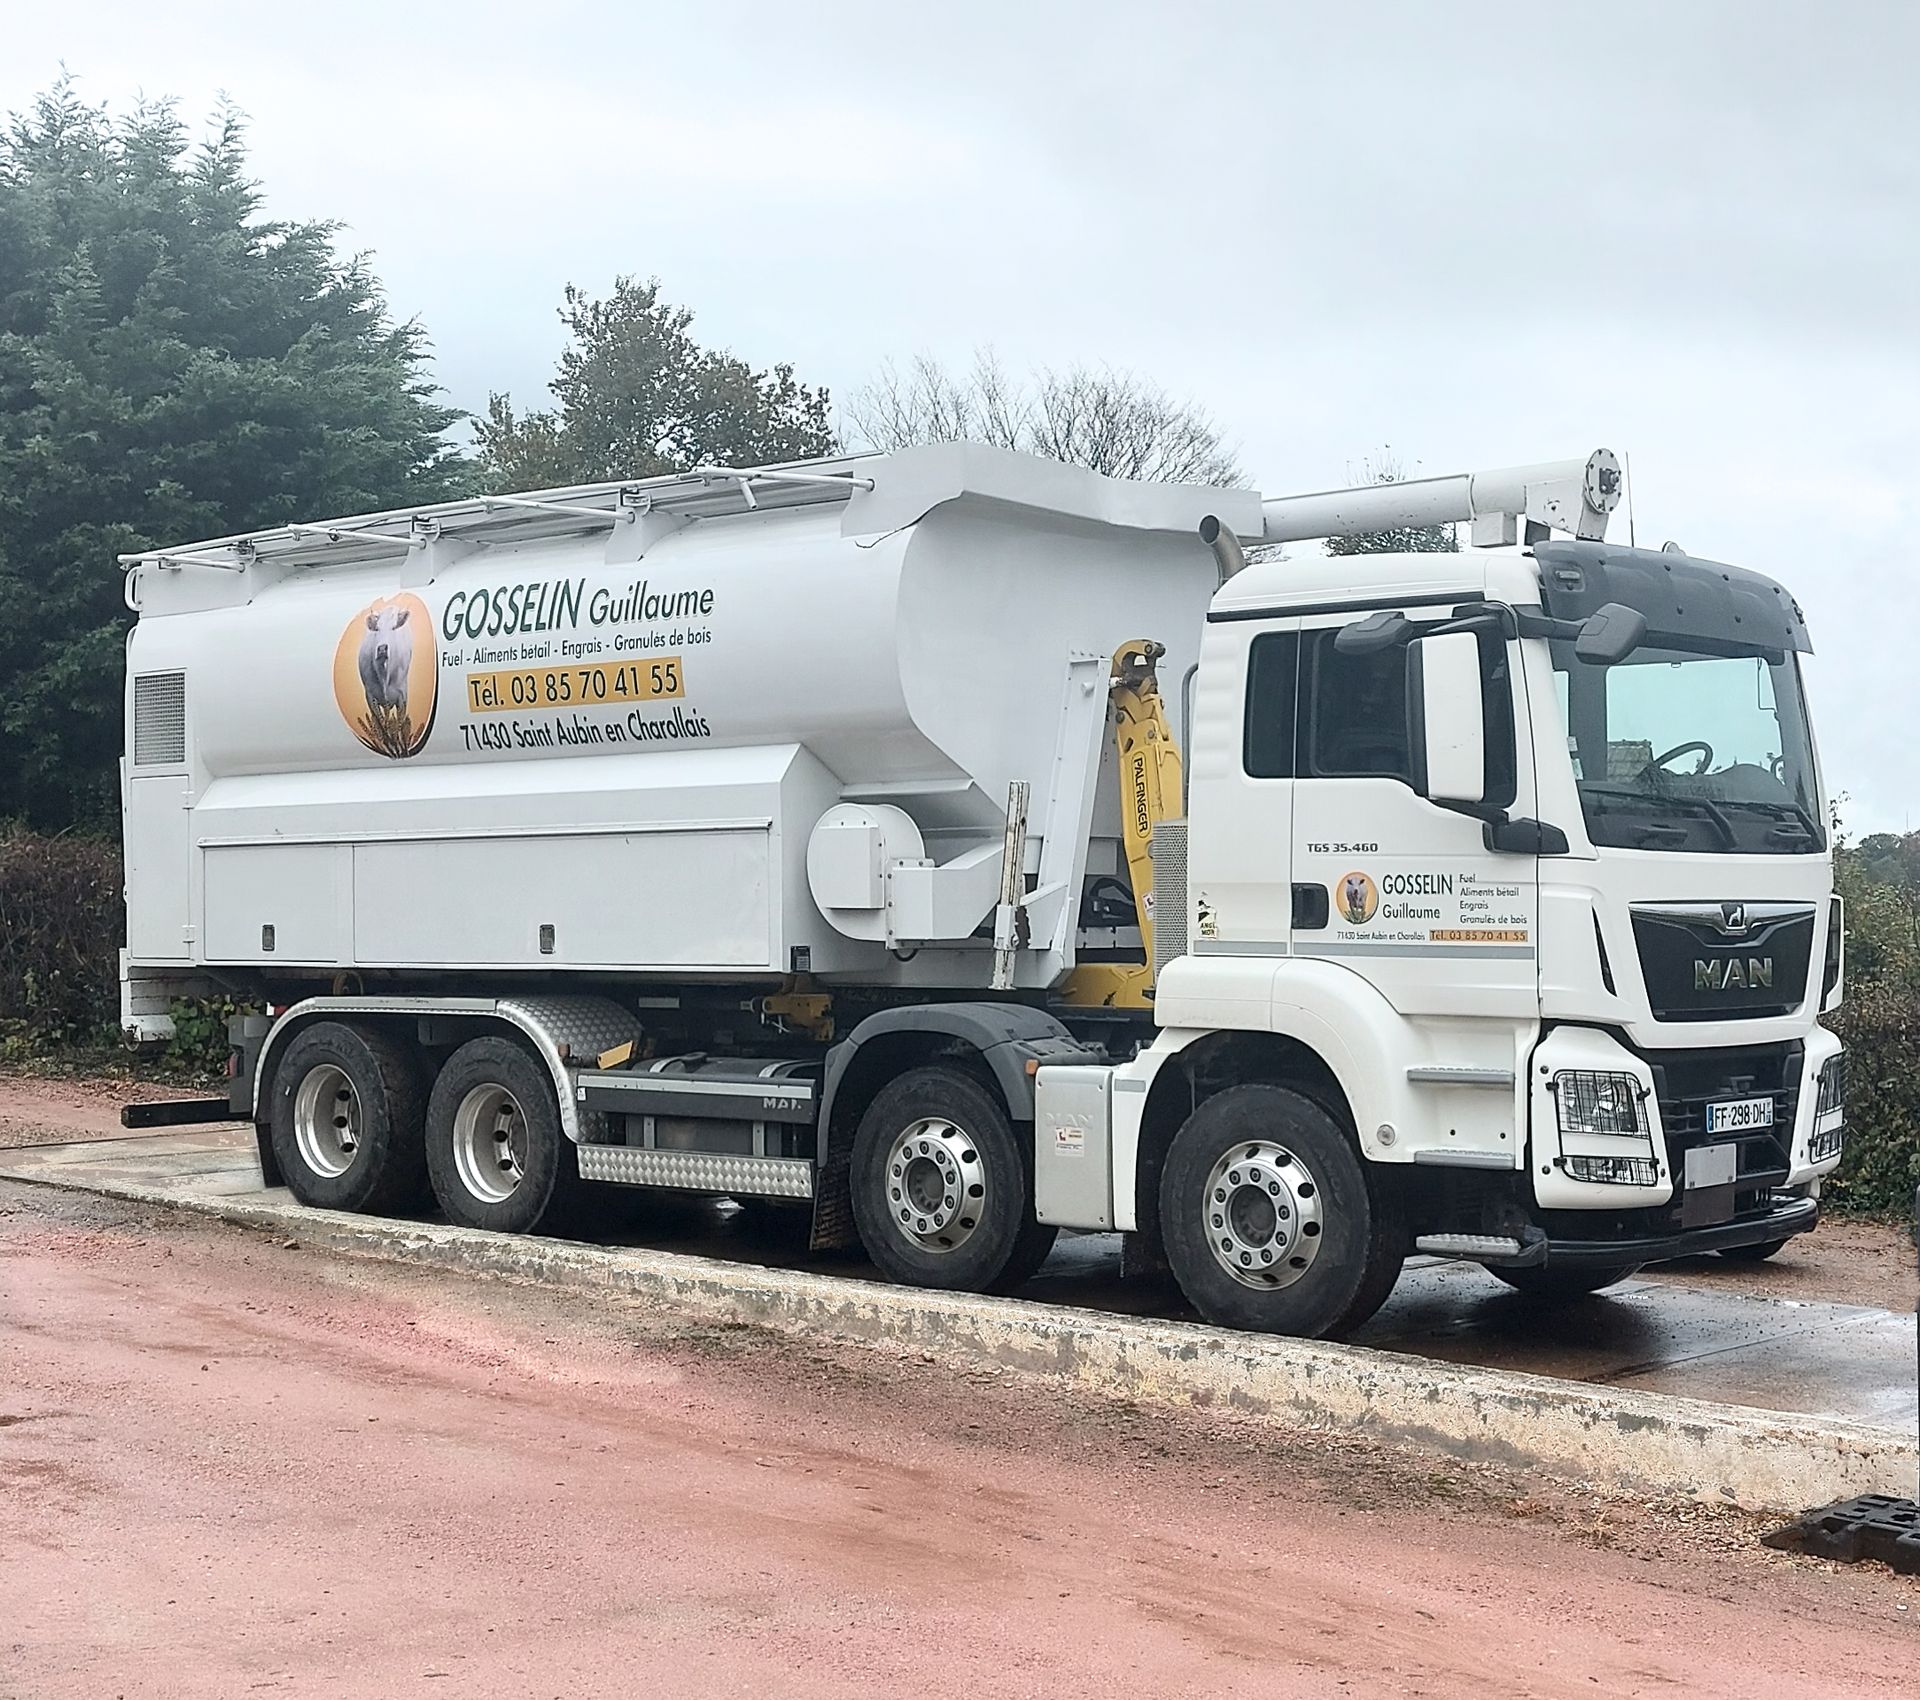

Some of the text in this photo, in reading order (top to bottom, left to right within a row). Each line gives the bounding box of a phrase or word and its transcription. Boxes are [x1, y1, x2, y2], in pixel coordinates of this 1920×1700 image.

[442, 578, 714, 641] GOSSELIN Guillaume
[442, 649, 463, 667] Fuel
[473, 646, 518, 664] Aliments
[562, 637, 602, 659] Engrais
[614, 630, 666, 651] Granulés
[669, 628, 684, 646] de
[687, 626, 712, 645] bois
[471, 663, 678, 707] Tél. 03 85 70 41 55
[460, 706, 711, 751] 71430 Saint Aubin en Charollais
[1307, 843, 1378, 852] TGS 35.460
[1382, 874, 1453, 895] GOSSELIN
[1459, 873, 1476, 883] Fuel
[1460, 887, 1494, 896] Aliments
[1382, 902, 1441, 918] Guillaume
[1459, 900, 1489, 911] Engrais
[1498, 914, 1508, 924] de
[1510, 914, 1528, 924] bois
[1449, 931, 1462, 940] 03
[1465, 931, 1478, 940] 85
[1481, 931, 1494, 940] 70
[1496, 931, 1509, 941] 41
[1513, 931, 1526, 941] 55
[1693, 957, 1773, 990] MAN
[1715, 1102, 1766, 1128] FF-298-DH
